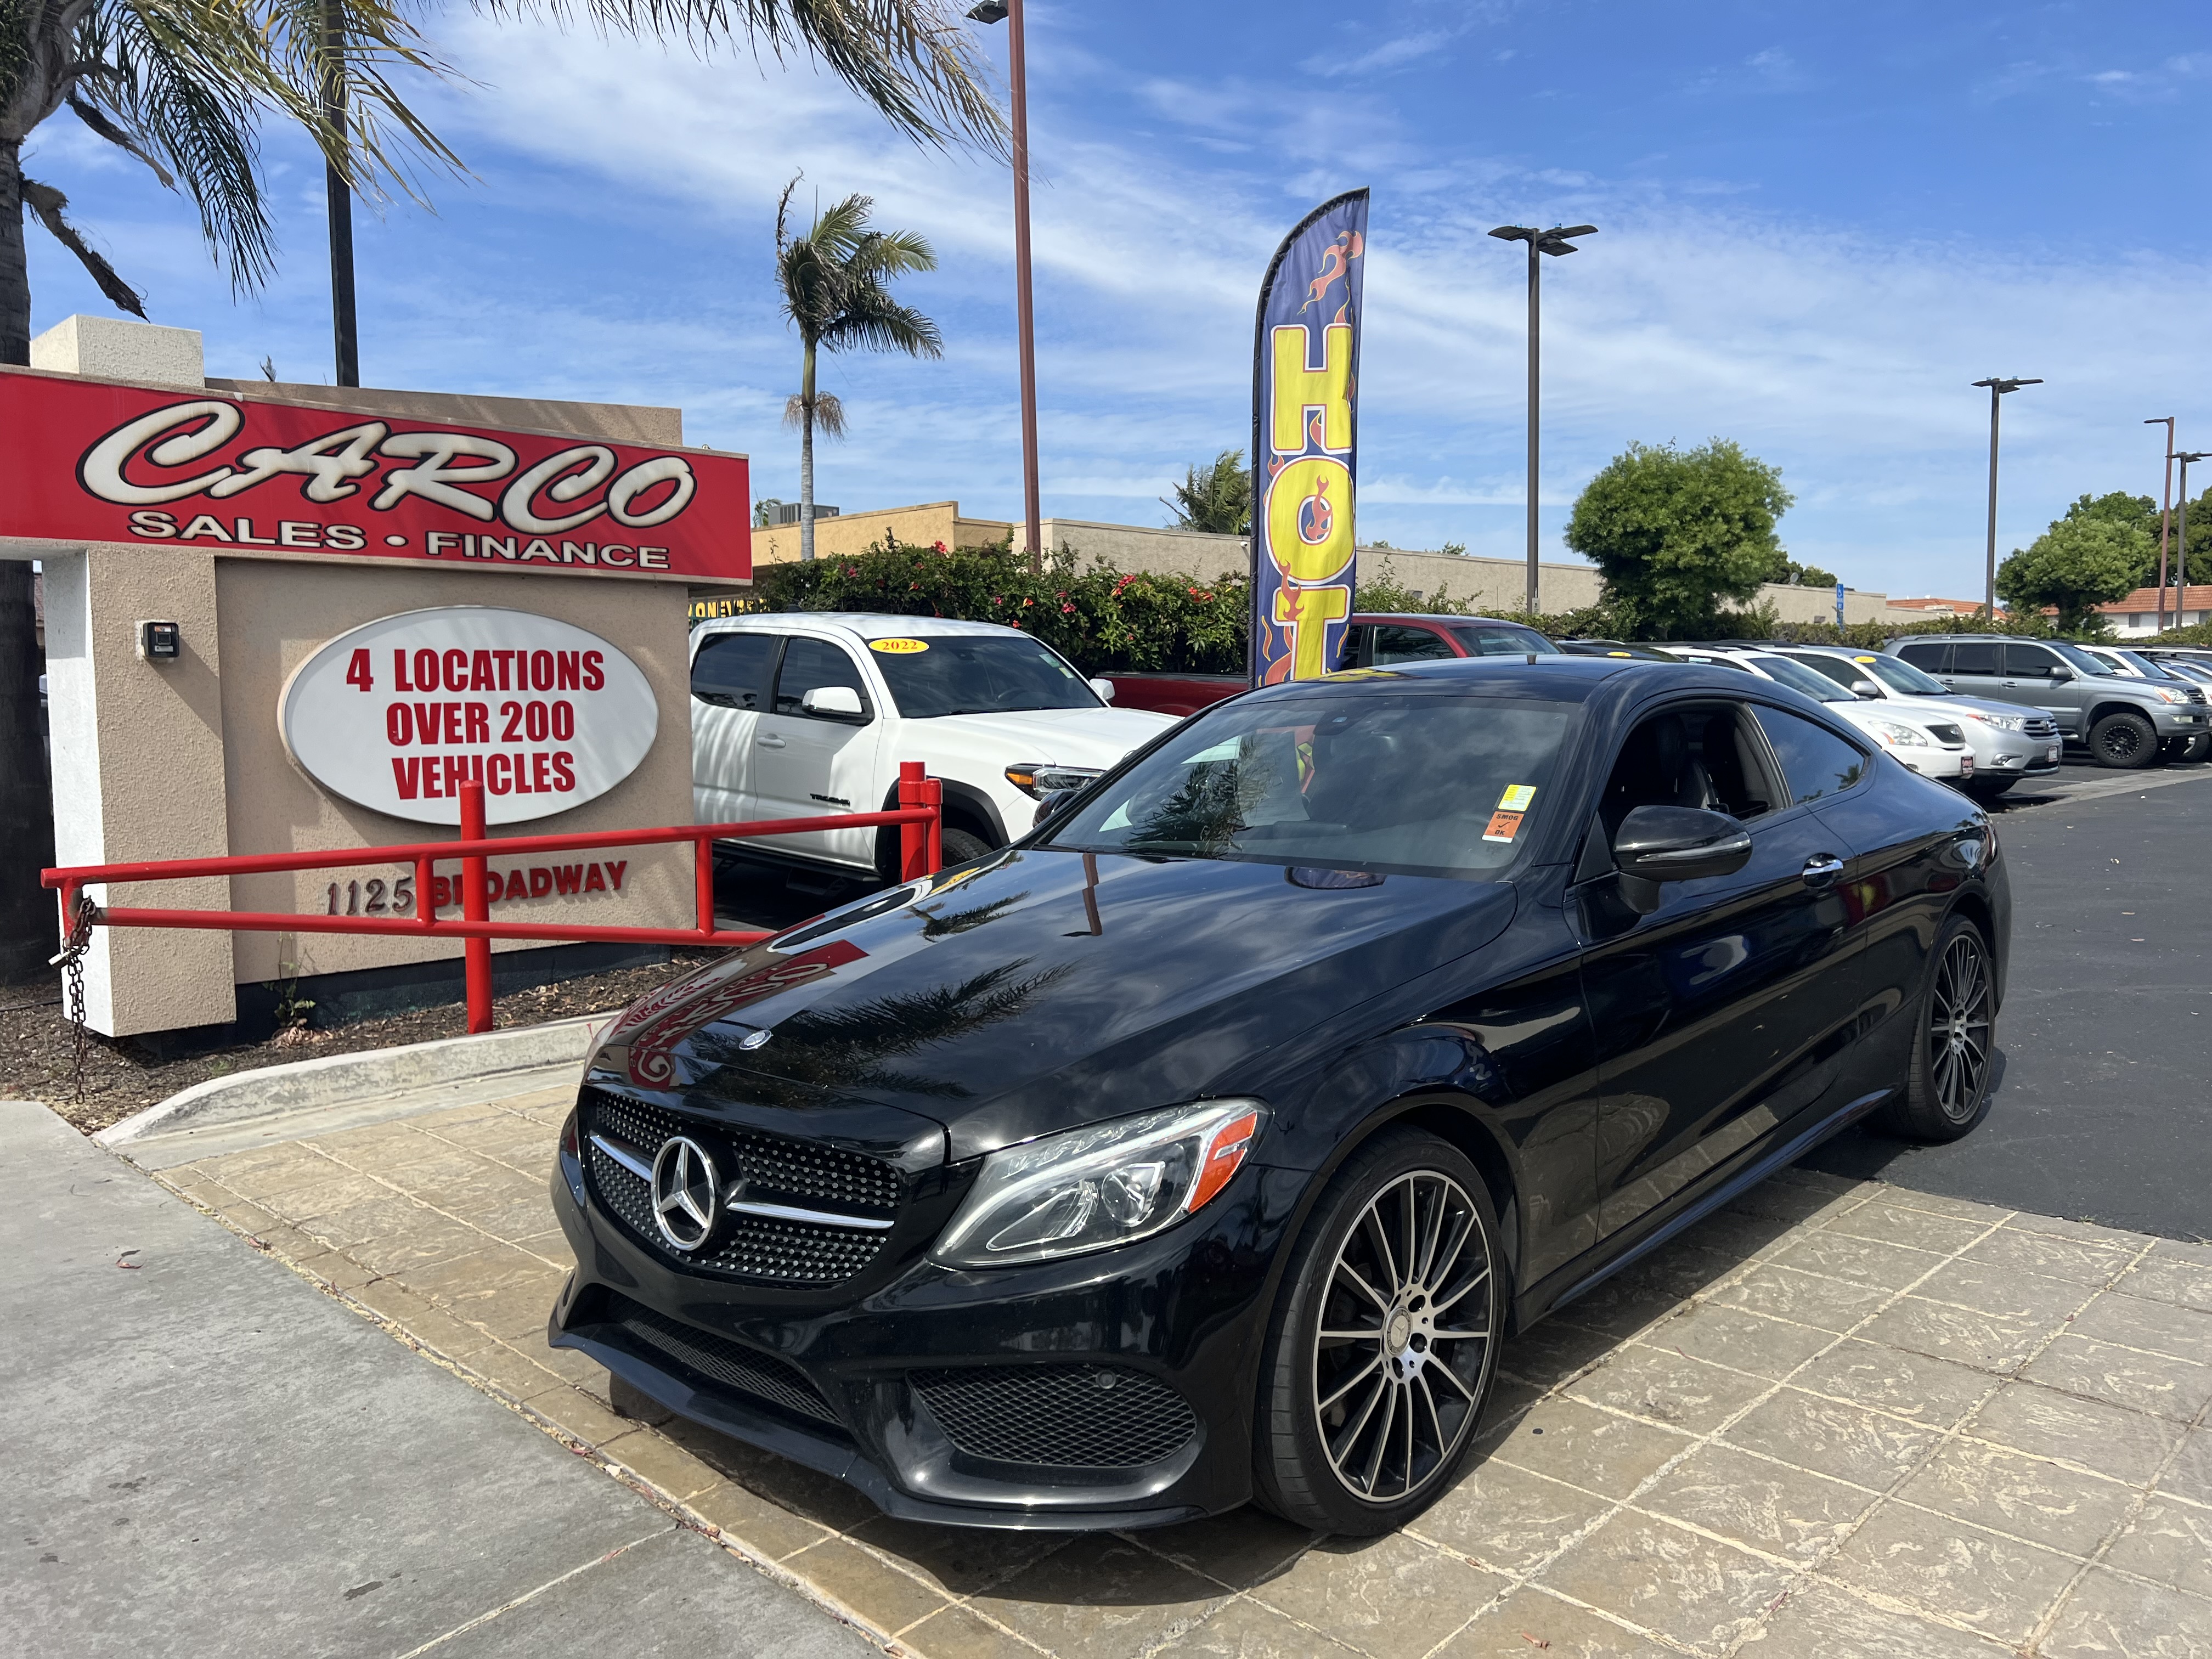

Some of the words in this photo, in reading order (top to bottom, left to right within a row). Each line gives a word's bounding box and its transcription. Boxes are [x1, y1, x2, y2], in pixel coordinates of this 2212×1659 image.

[76, 399, 697, 535] CARCO
[1264, 323, 1356, 680] HOT
[128, 510, 367, 550] SALES
[425, 530, 670, 569] FINANCE
[882, 641, 918, 650] 2022
[346, 648, 374, 692] 4
[394, 648, 605, 692] LOCATIONS
[386, 701, 490, 747] OVER
[500, 700, 574, 743] 200
[392, 751, 576, 800] VEHICLES
[327, 877, 413, 915] 1125
